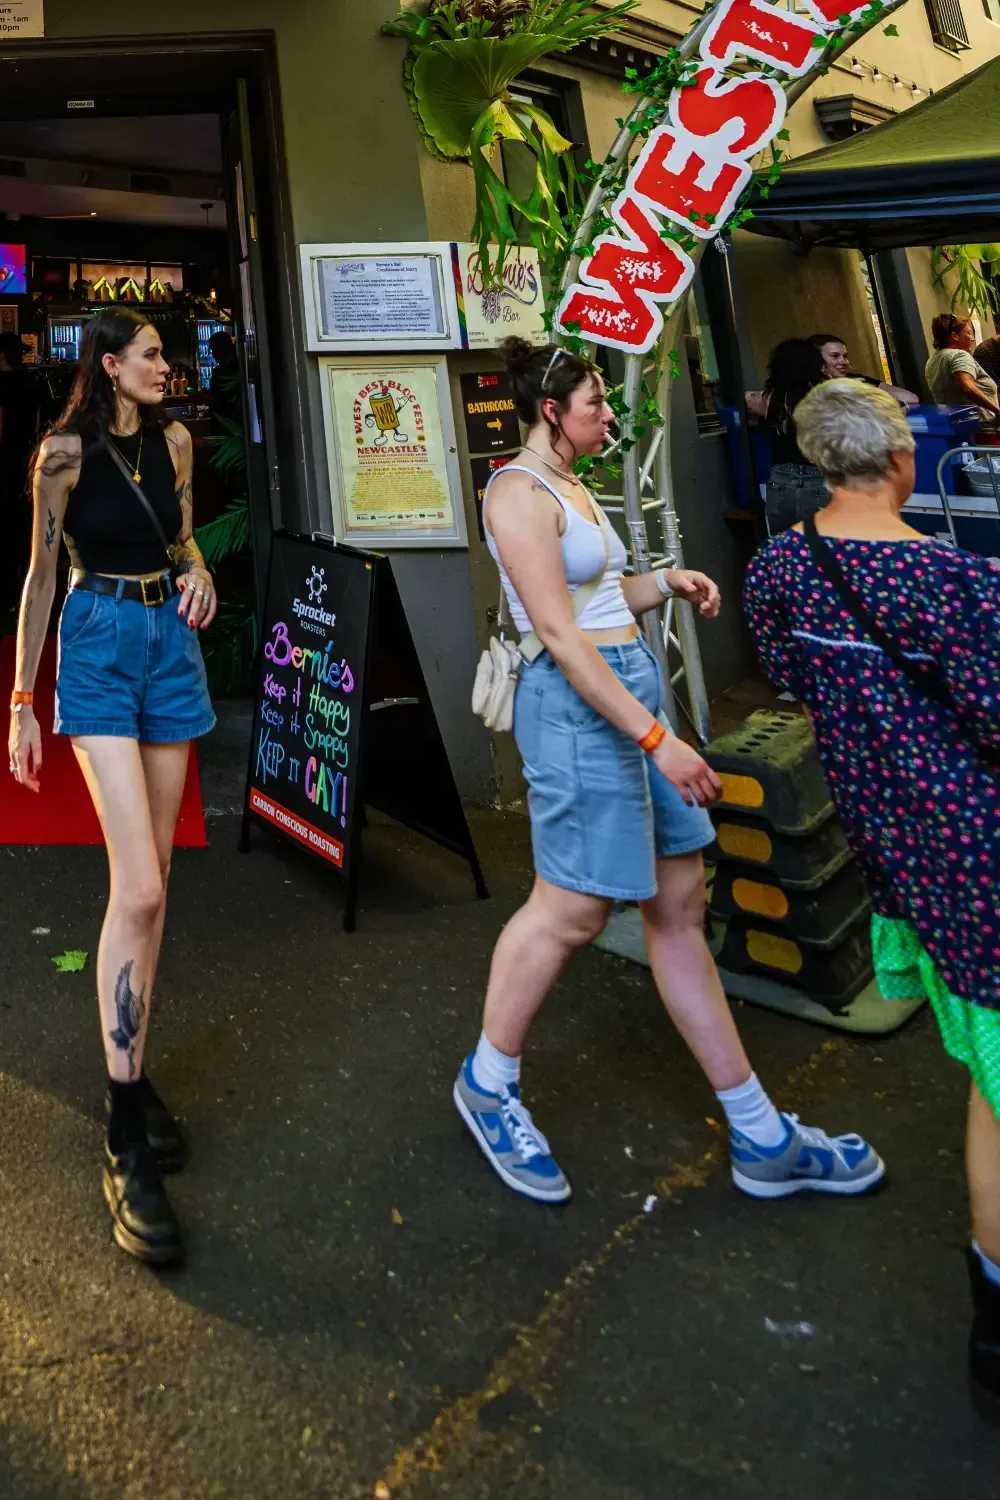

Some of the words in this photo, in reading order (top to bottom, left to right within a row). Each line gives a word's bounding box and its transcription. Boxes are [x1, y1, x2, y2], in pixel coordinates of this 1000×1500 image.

[502, 305, 521, 322] Bar
[358, 379, 385, 399] BEST
[387, 379, 417, 403] BLOC
[467, 398, 515, 414] BATHROOMS
[353, 398, 362, 434] WEST
[412, 404, 424, 431] FEST
[357, 444, 427, 455] NEWCASTLE'S
[292, 597, 337, 627] Sprocket
[300, 620, 326, 637] ROASTERS
[264, 621, 354, 693] Bernie's
[263, 673, 287, 705] Keep
[292, 676, 302, 707] it
[309, 682, 350, 737] Happy
[260, 699, 284, 732] Keep
[290, 710, 301, 735] it
[303, 713, 348, 769] Snappy
[255, 727, 285, 785] KEEP
[287, 756, 301, 783] IT
[304, 755, 348, 828] GAY!
[252, 794, 275, 817] CARBON
[275, 809, 308, 839] CONSCIOUS
[308, 830, 340, 860] ROASTING
